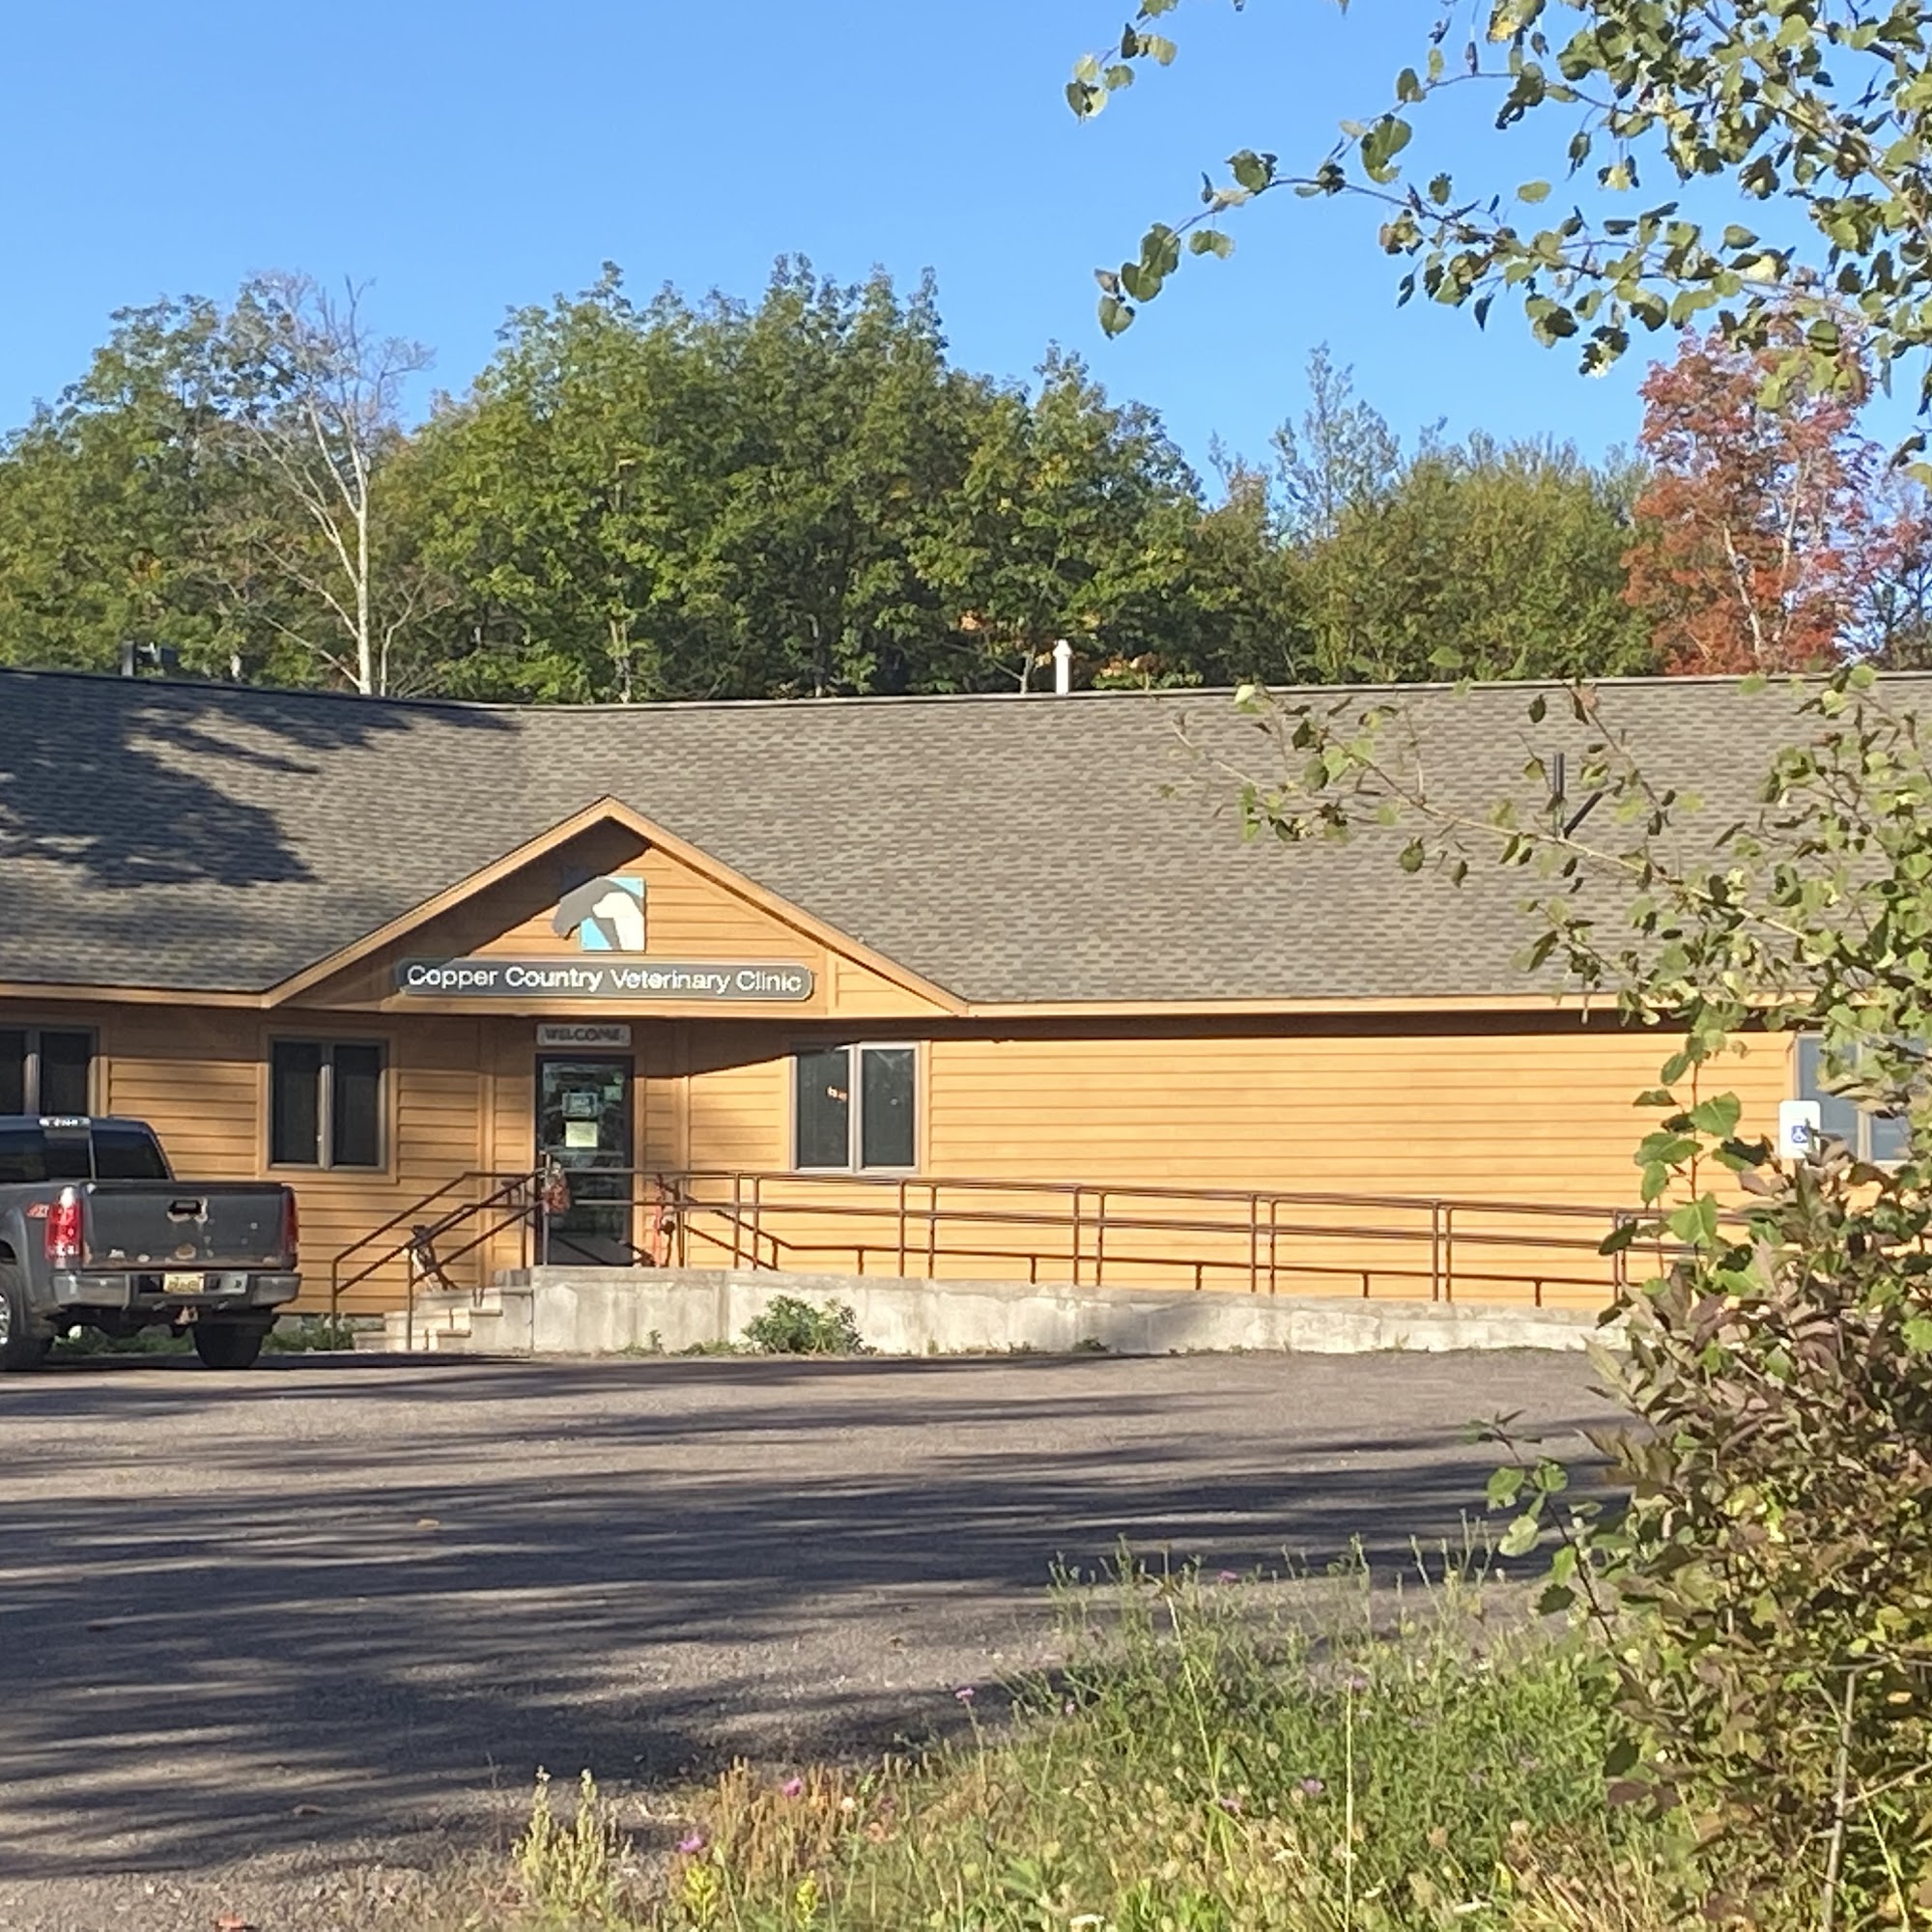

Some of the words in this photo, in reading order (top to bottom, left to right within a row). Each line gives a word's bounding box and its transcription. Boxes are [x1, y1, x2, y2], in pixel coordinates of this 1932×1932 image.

[407, 965, 498, 989] Copper
[505, 967, 603, 992] Country
[610, 969, 731, 995] Veterinary
[737, 971, 802, 992] Clinic
[543, 1028, 621, 1042] WELCOME
